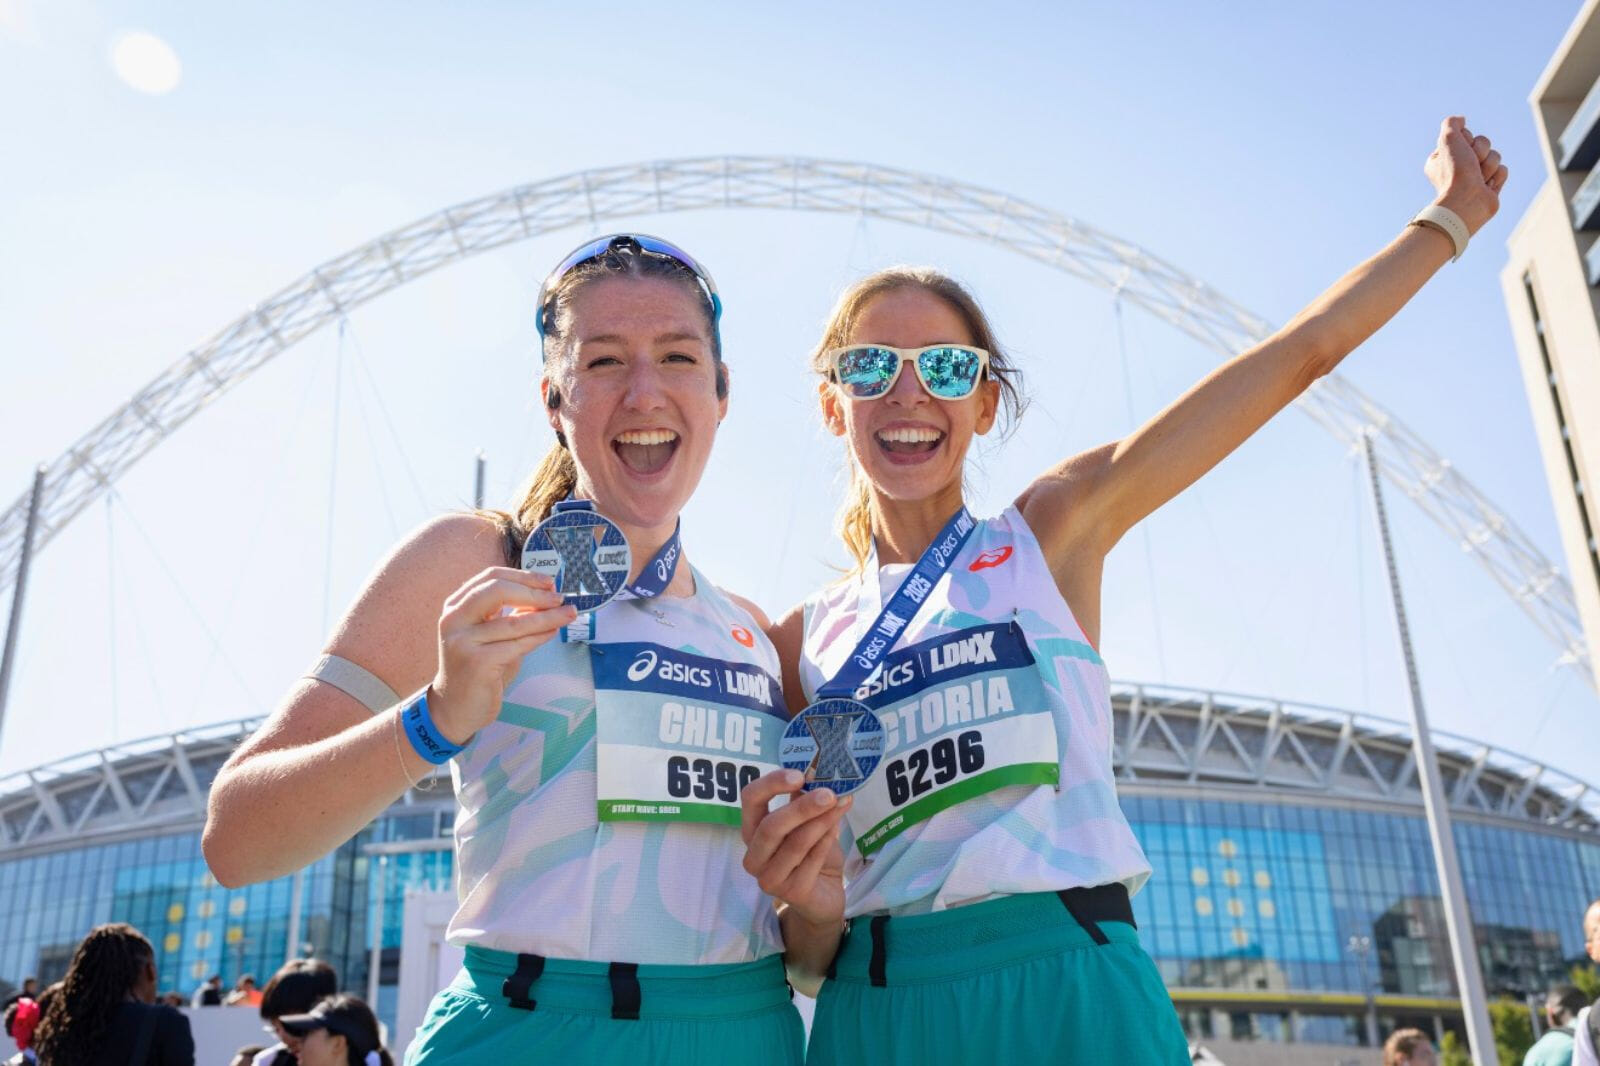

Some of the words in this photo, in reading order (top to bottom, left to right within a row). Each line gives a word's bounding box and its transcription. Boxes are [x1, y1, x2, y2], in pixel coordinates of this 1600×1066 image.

[903, 573, 931, 604] 2025
[930, 631, 997, 674] LDNX
[725, 669, 773, 707] LDNX
[658, 702, 763, 756] CHLOE
[879, 676, 1015, 753] CTORIA
[886, 730, 986, 807] 6296
